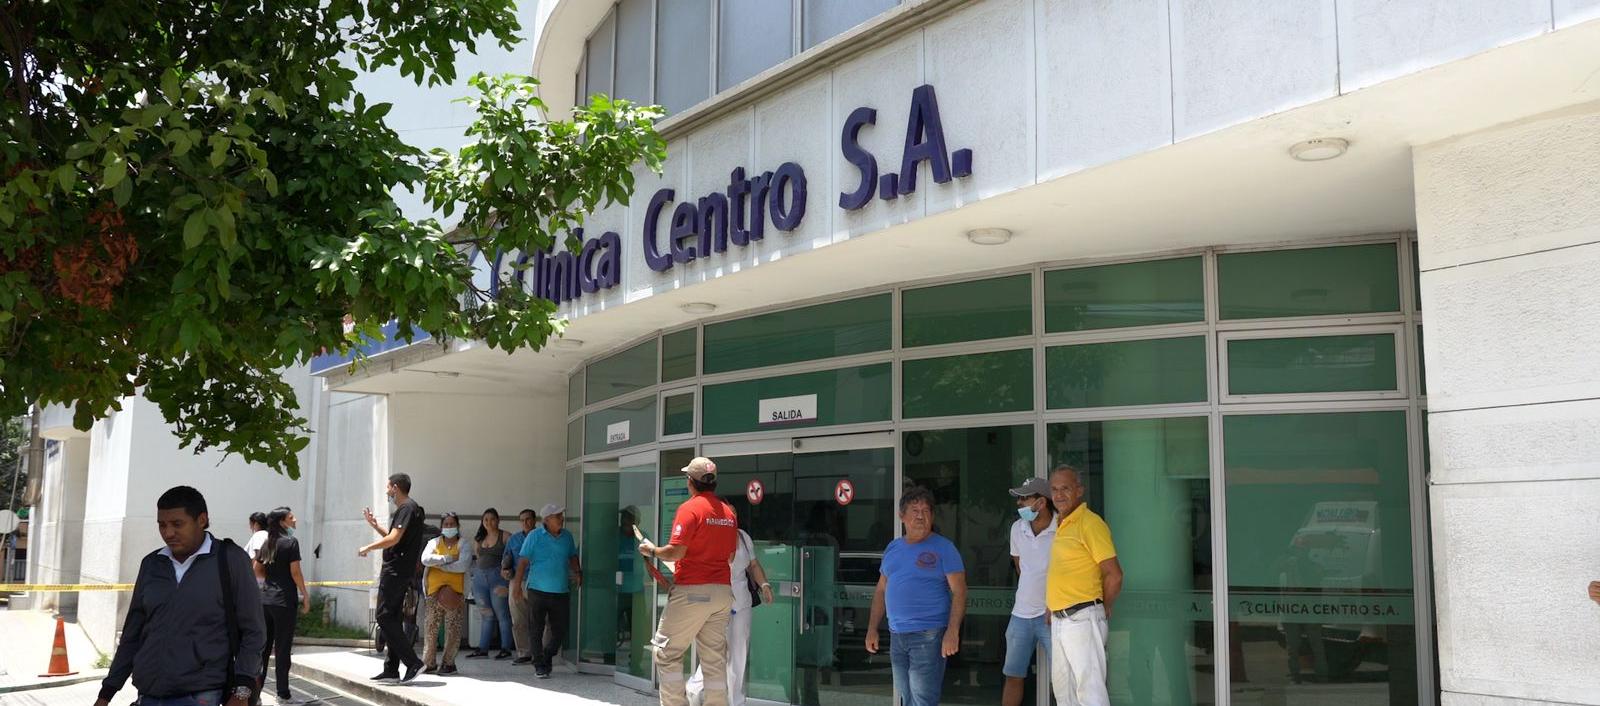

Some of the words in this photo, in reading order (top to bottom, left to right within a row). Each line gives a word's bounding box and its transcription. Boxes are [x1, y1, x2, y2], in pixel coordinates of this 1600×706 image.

[642, 161, 808, 273] Centro
[838, 83, 973, 211] S.A.
[772, 409, 803, 421] SALIDA
[1255, 600, 1310, 615] CLÍNICA
[1312, 604, 1369, 616] CENTRO
[1372, 604, 1400, 617] S.A.
